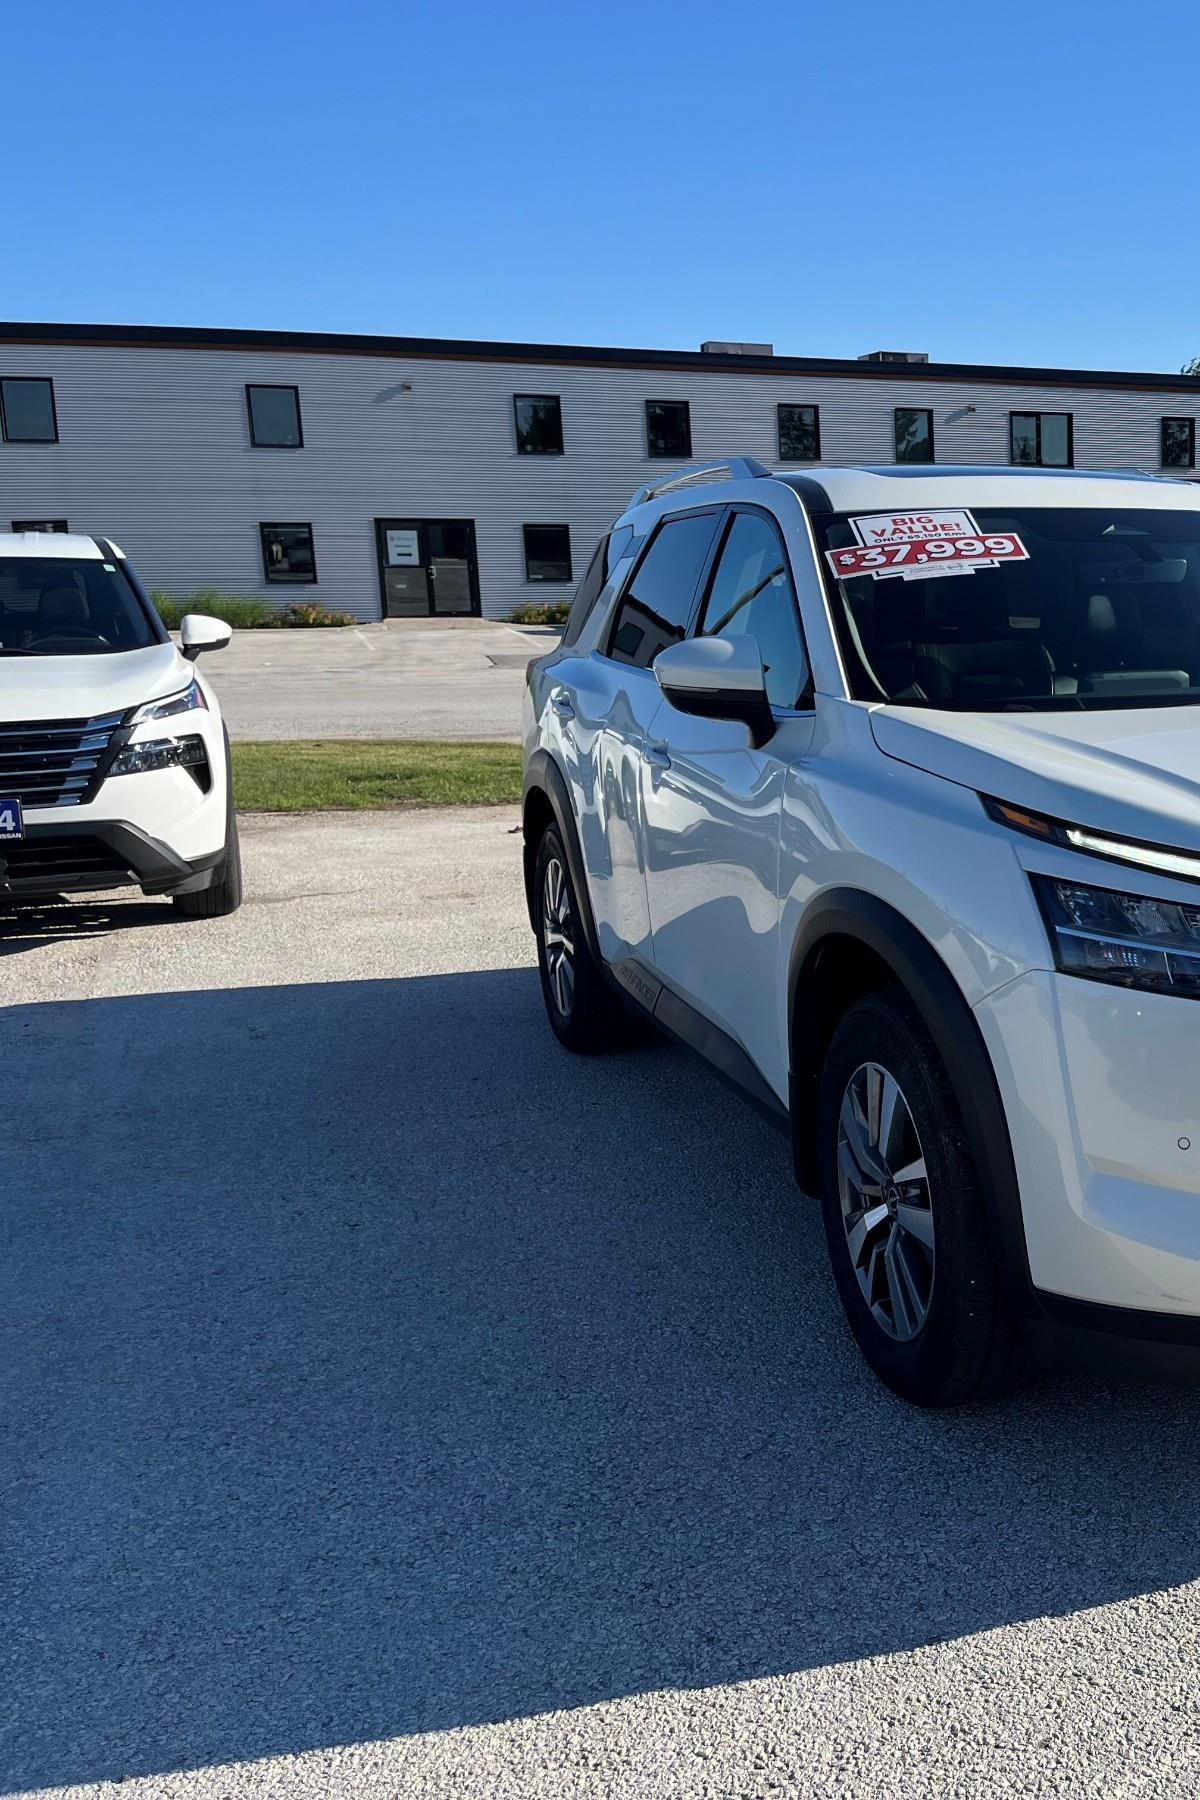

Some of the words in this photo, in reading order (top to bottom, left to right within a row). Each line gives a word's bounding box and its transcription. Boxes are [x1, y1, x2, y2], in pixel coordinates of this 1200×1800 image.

[891, 516, 934, 526] BIG
[869, 522, 962, 539] VALUE!
[874, 536, 903, 544] ONLY
[839, 538, 1015, 568] $37,999
